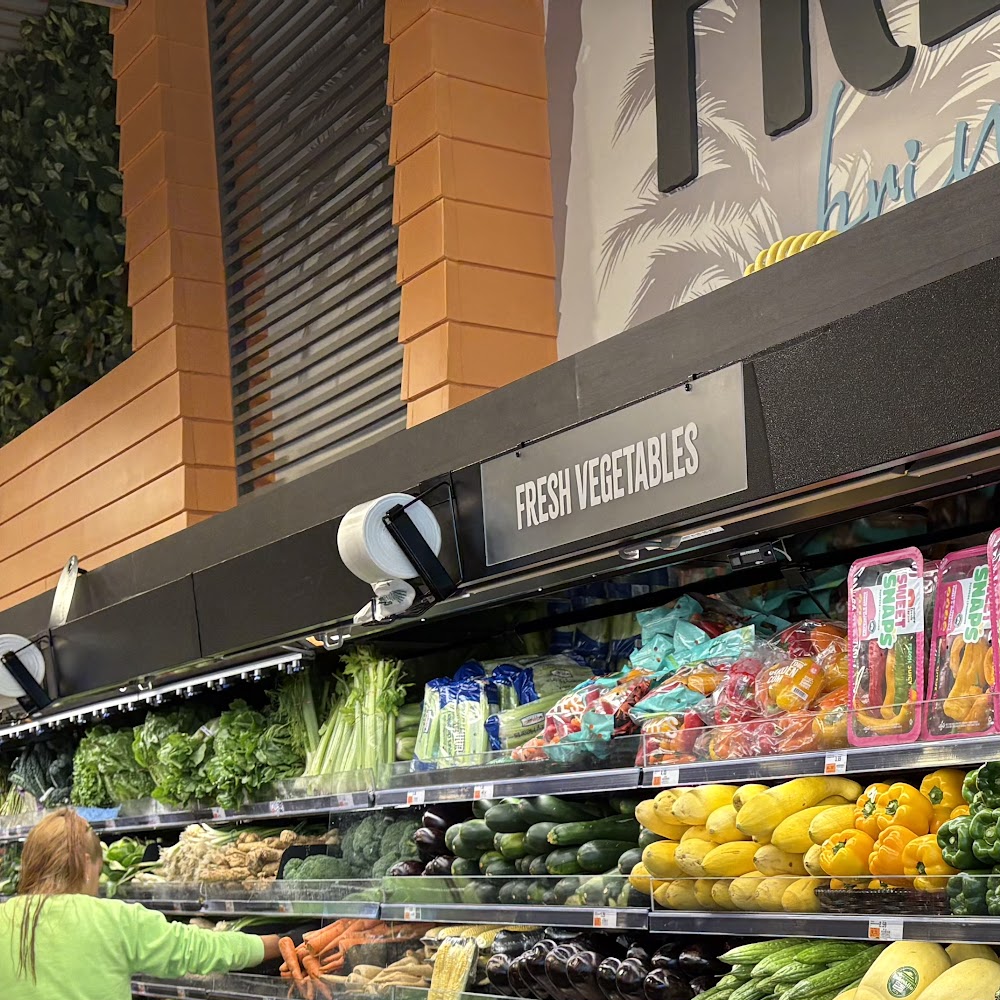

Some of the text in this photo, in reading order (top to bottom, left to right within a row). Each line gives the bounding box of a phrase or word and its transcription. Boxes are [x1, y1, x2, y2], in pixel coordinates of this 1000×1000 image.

[515, 421, 699, 530] FRESH VEGETABLES
[879, 573, 897, 648] SNAPS
[895, 574, 908, 628] SWEET
[965, 566, 989, 642] SNAPS
